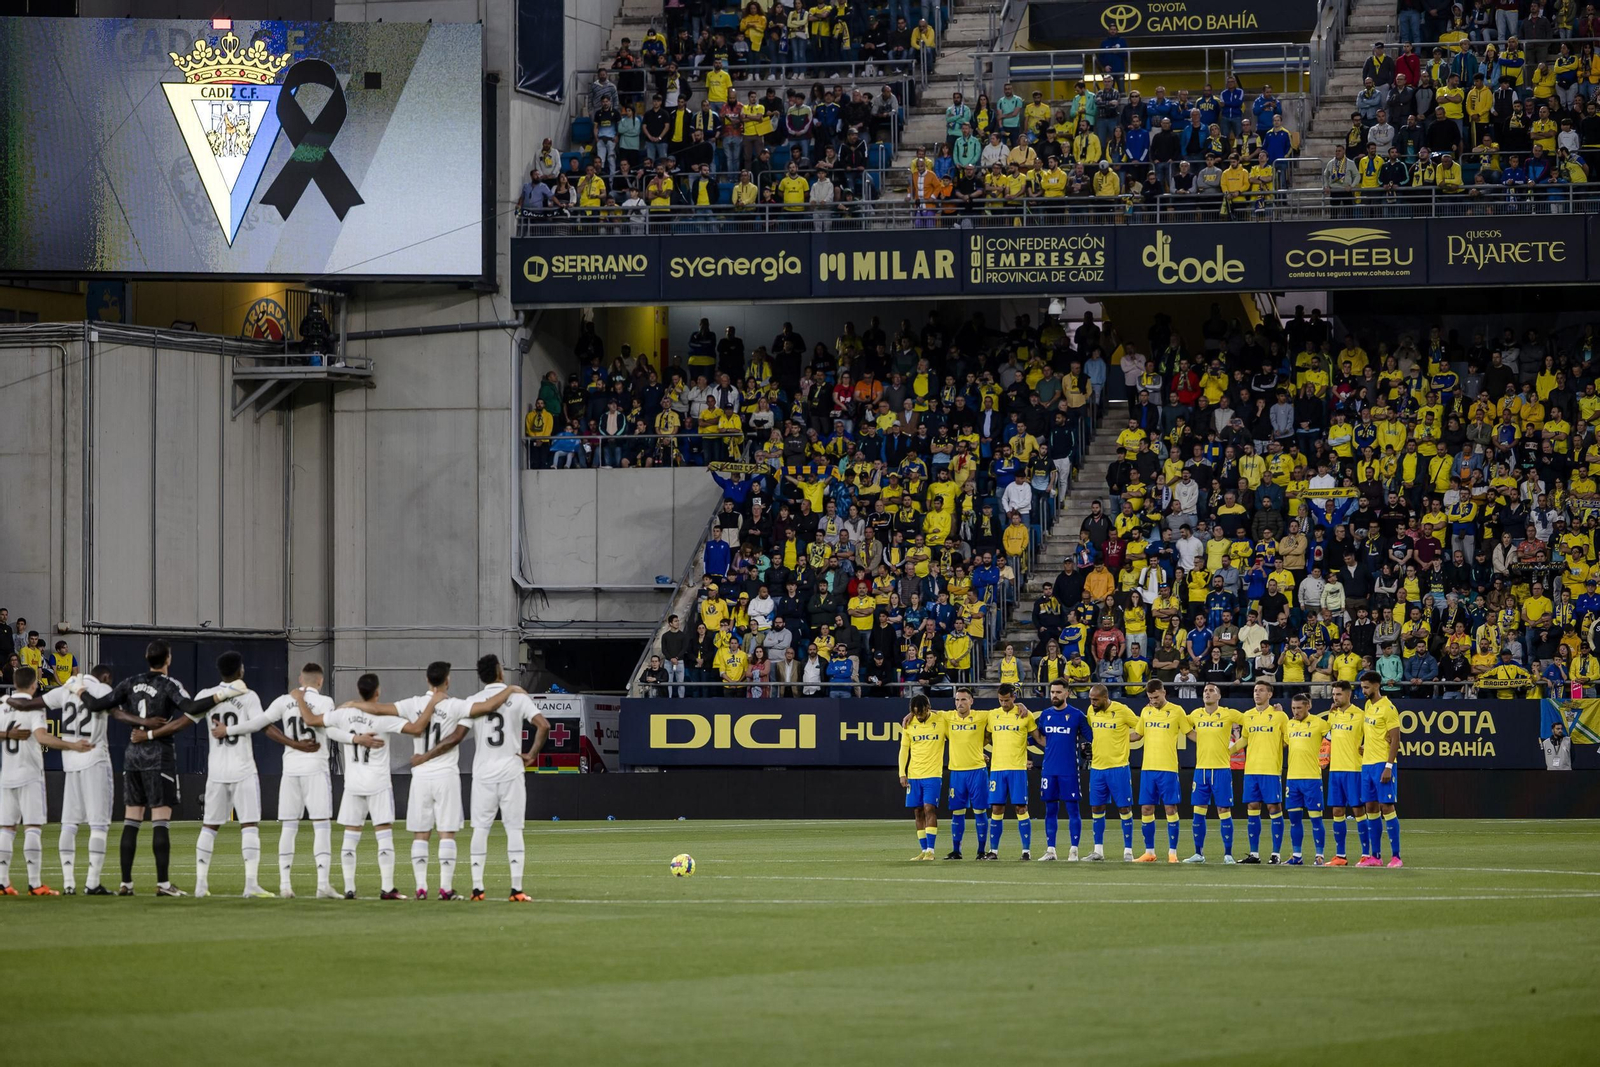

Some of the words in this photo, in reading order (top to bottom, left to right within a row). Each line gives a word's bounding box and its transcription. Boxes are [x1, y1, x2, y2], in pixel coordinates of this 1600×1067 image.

[1147, 3, 1187, 13] TOYOTA
[1147, 15, 1202, 31] GAMO
[1207, 10, 1258, 30] BAHÍA
[200, 88, 236, 98] CADIZ
[239, 88, 259, 98] C.F.
[986, 233, 1105, 251] CONFEDERACIÓN
[1465, 229, 1502, 241] quesos
[551, 254, 648, 273] SERRANO
[853, 249, 955, 281] MILAR
[986, 251, 1105, 267] EMPRESAS
[1285, 247, 1414, 268] COHEBU
[986, 271, 1048, 283] PROVINCIA
[1051, 270, 1066, 282] DE
[1068, 268, 1104, 282] CÁDIZ
[1352, 269, 1411, 277] www.cohebu.com
[65, 701, 92, 737] 22
[1331, 723, 1353, 731] DIGI
[1398, 710, 1496, 735] OYOTA
[487, 711, 504, 746] 3
[606, 728, 619, 739] Cruz
[650, 714, 816, 749] DIGI
[1045, 726, 1071, 734] DIGI
[1398, 741, 1435, 757] AMO
[1438, 737, 1496, 757] BAHÍA
